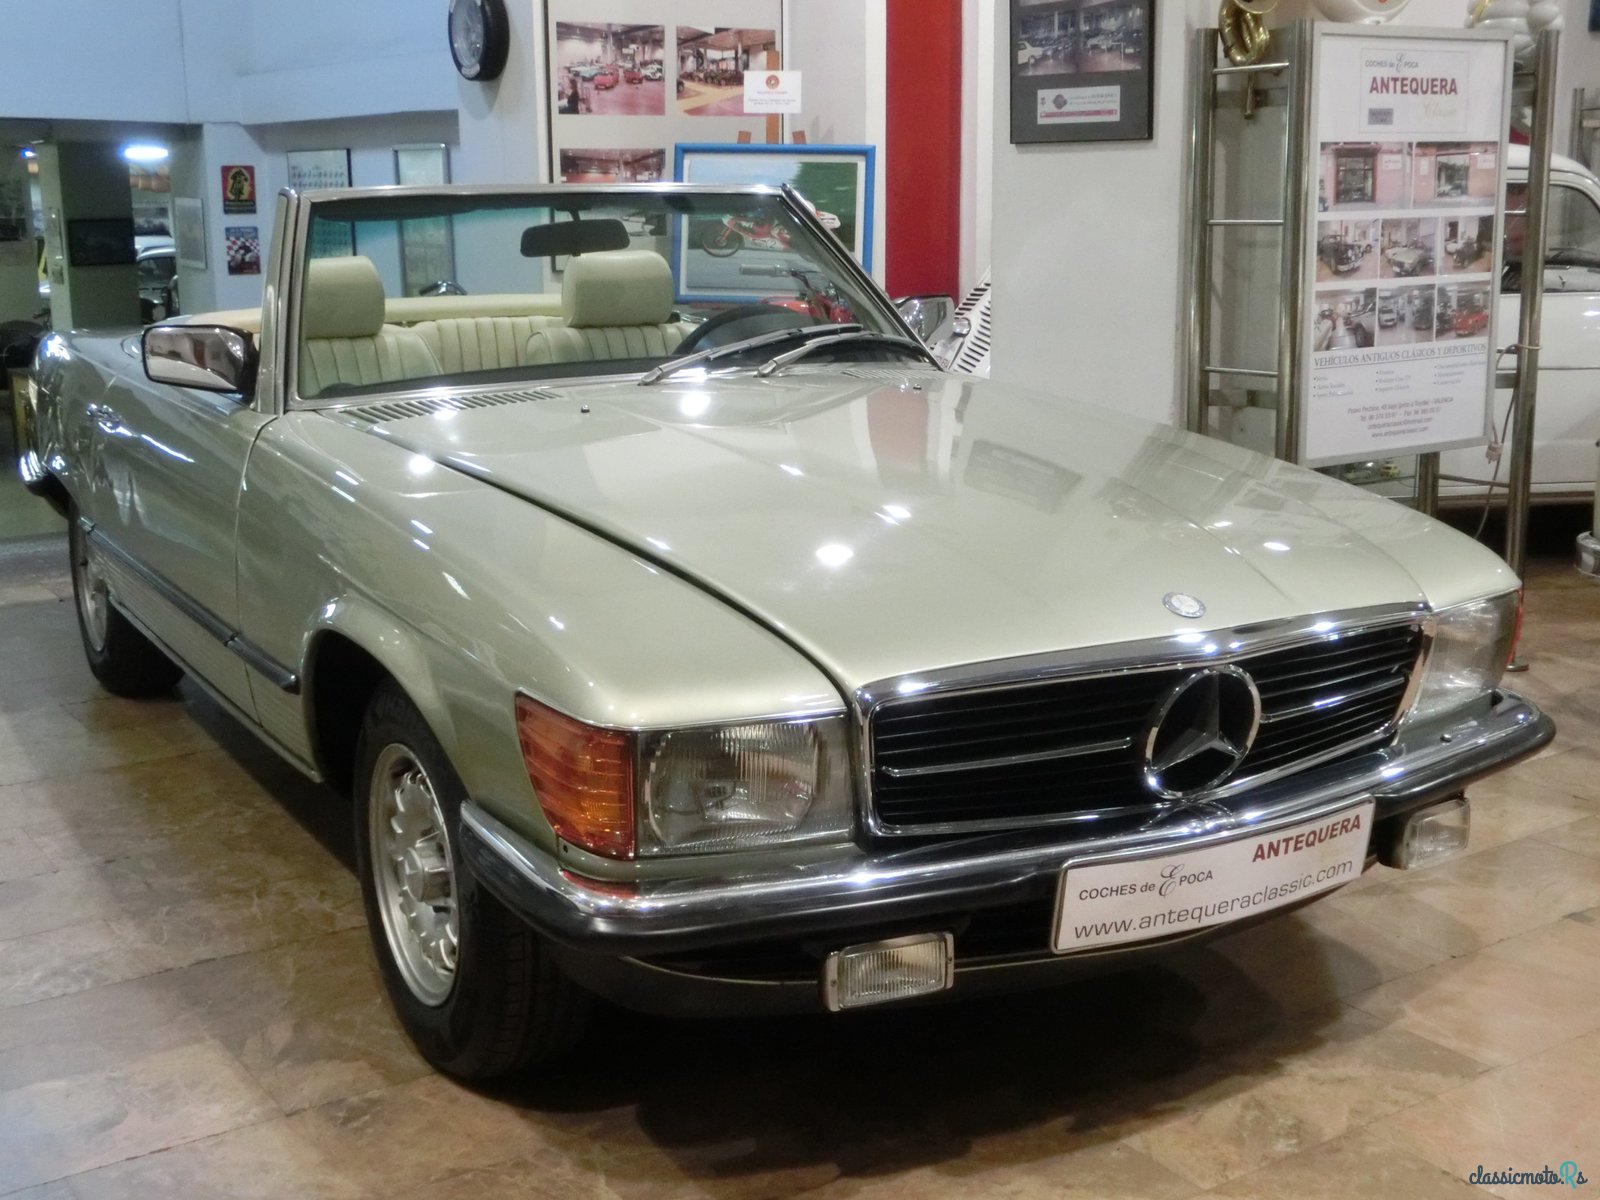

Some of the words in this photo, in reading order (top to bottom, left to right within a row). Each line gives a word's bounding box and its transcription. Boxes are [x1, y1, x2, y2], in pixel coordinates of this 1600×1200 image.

[1369, 76, 1458, 95] ANTEQUERA
[1314, 353, 1359, 367] VEHÍCULOS
[1361, 349, 1400, 362] ANTIGUOS
[1437, 347, 1443, 355] Y
[1443, 343, 1487, 355] DEPORTIVOS
[1252, 814, 1361, 863] ANTEQUERA
[1074, 860, 1353, 939] www.antequeraclassic.com
[1079, 883, 1137, 900] COCHES
[1140, 881, 1156, 893] de
